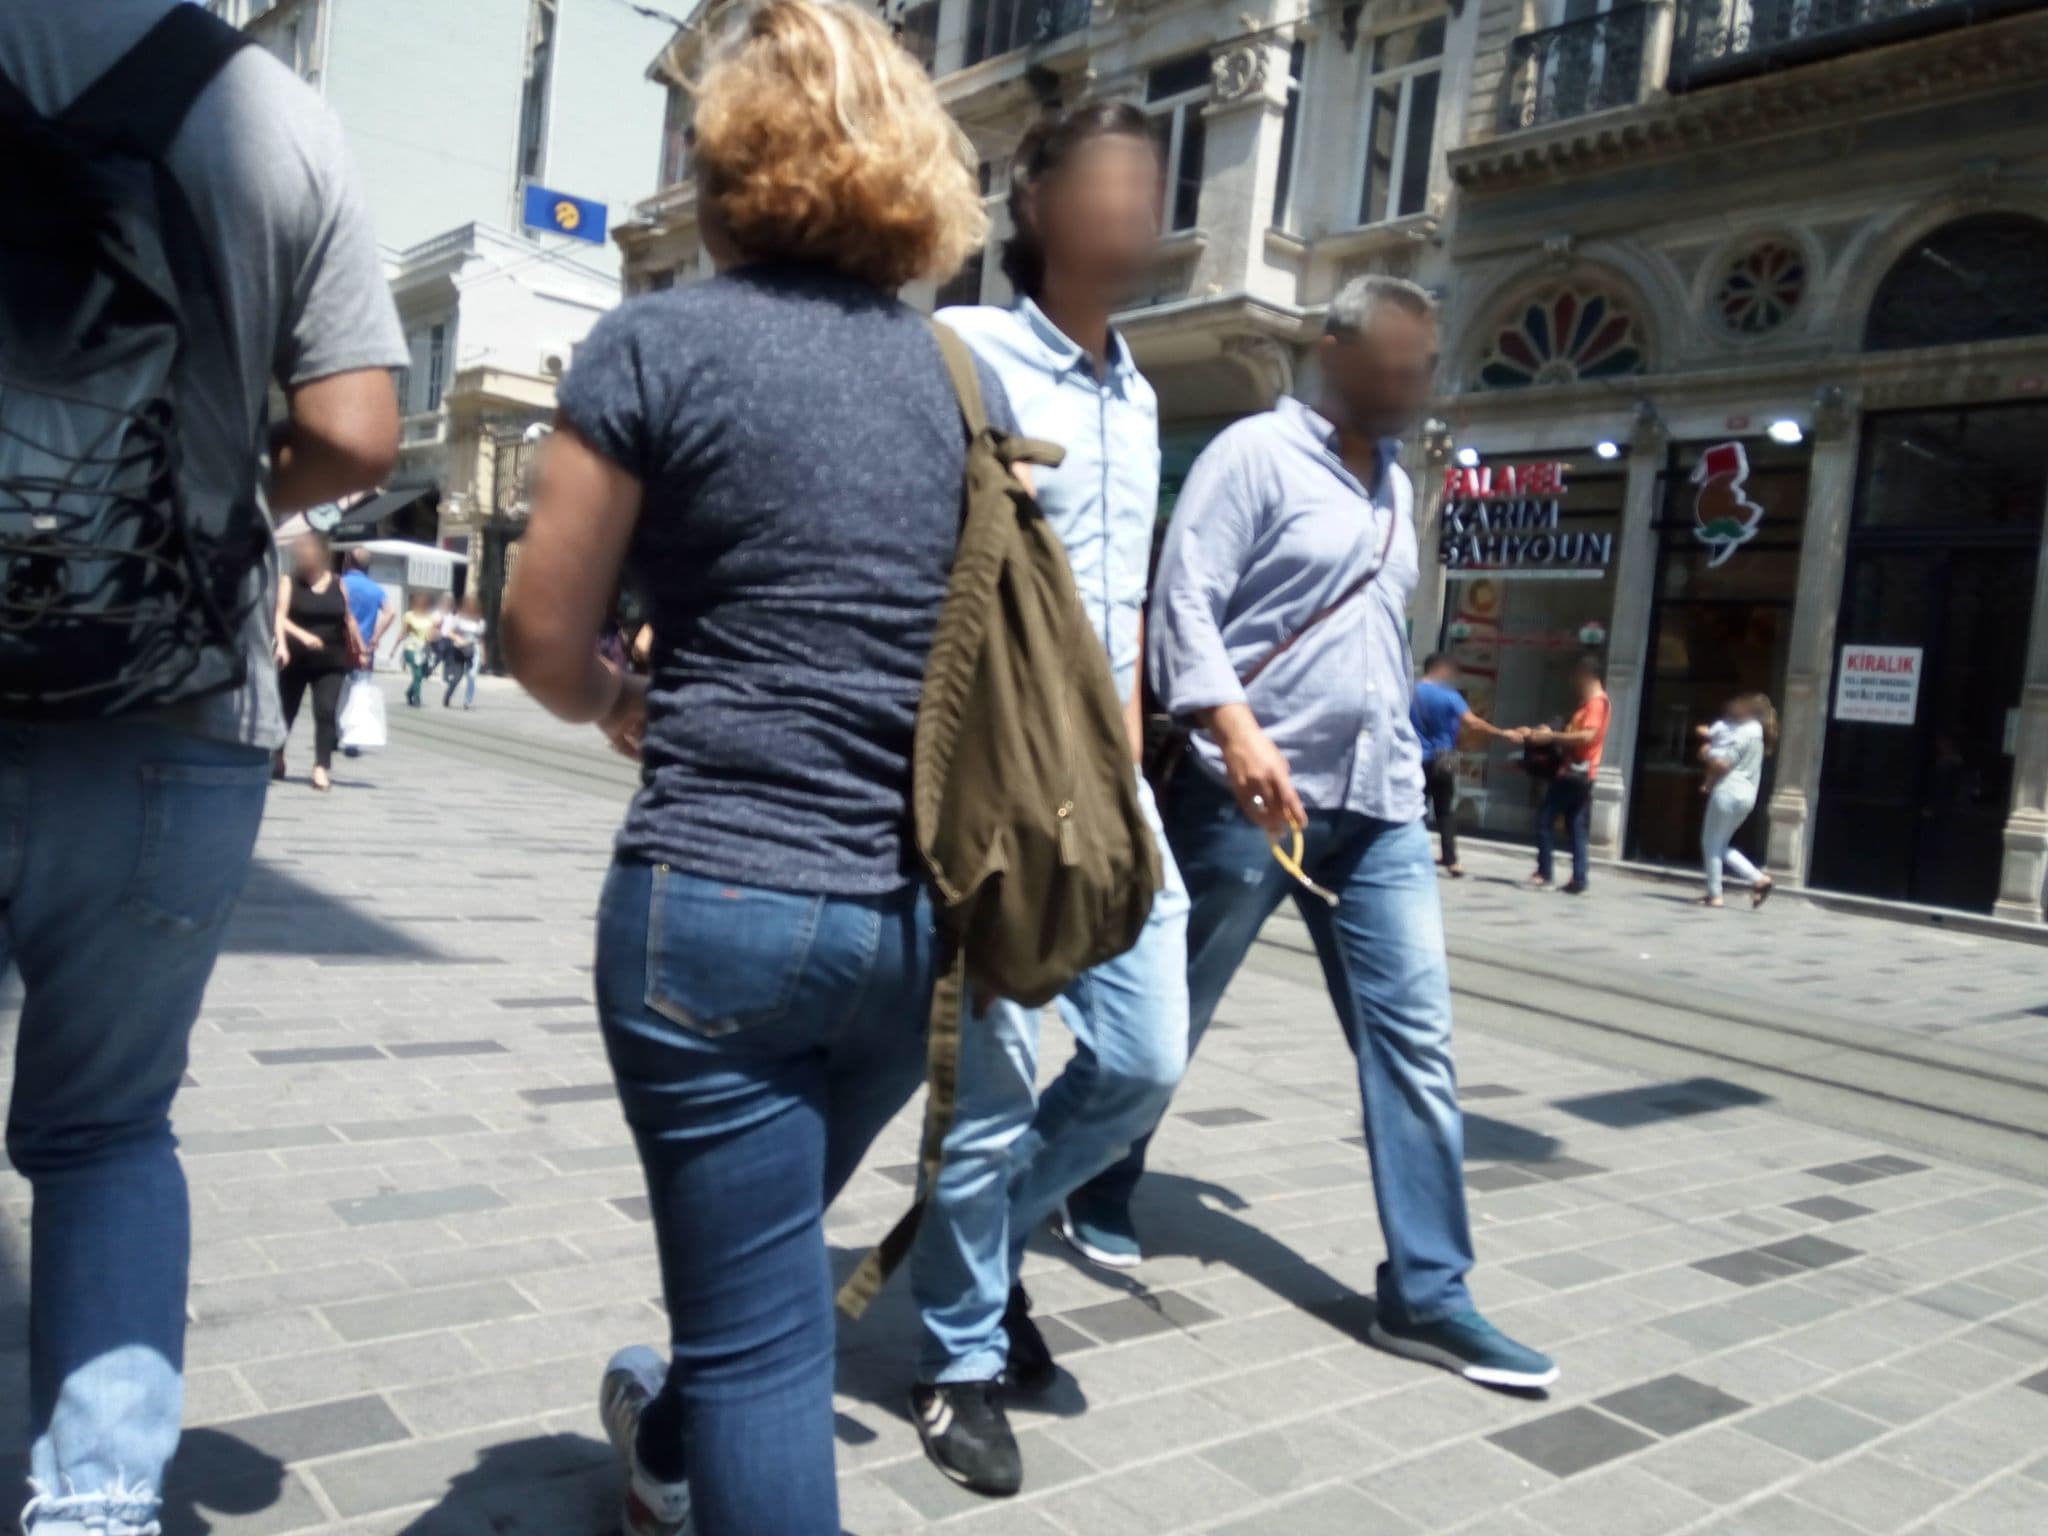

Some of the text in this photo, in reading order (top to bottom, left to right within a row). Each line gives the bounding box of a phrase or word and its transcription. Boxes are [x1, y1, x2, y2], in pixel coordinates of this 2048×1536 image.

[1443, 463, 1568, 497] FALAFEL
[1442, 499, 1559, 533] KARIM
[1440, 532, 1612, 565] SAHYOUN
